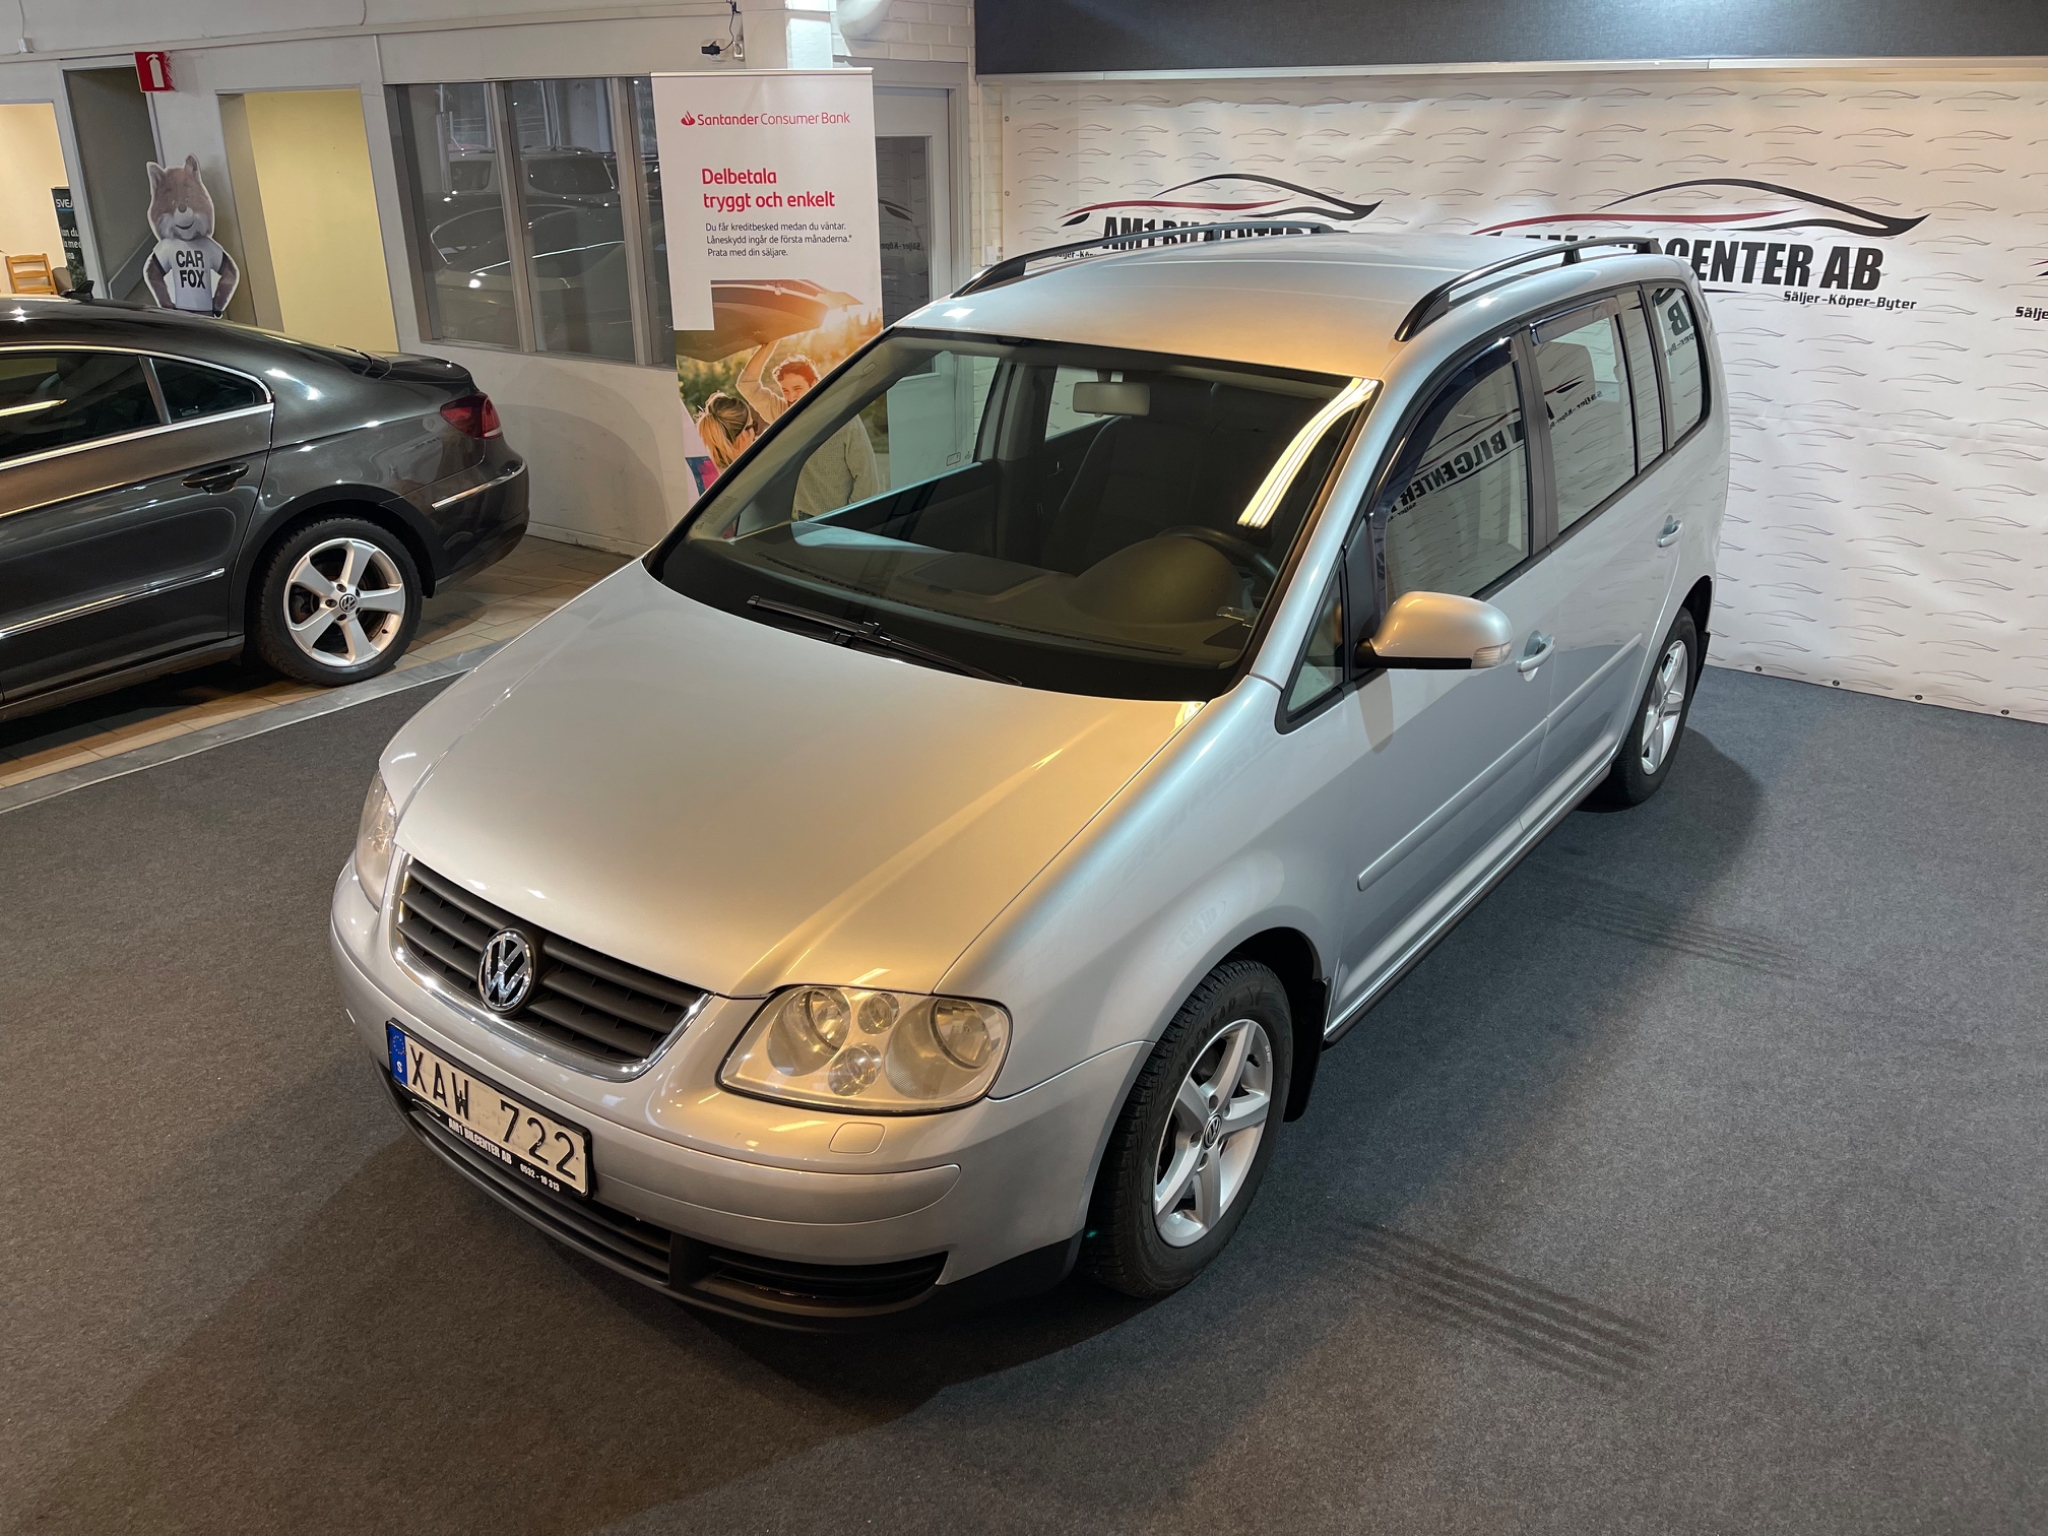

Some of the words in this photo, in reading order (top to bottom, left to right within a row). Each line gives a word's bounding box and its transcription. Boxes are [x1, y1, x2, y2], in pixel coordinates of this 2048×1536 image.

[697, 113, 759, 126] Santander
[760, 112, 819, 125] Consumer
[821, 111, 851, 124] Bank
[701, 167, 777, 185] Delbetala
[55, 198, 74, 208] SVE
[703, 192, 751, 213] tryggt
[755, 191, 783, 208] och
[787, 190, 836, 207] enkelt
[705, 222, 717, 232] Du
[718, 222, 729, 232] får
[730, 222, 779, 232] kreditbesked
[780, 222, 807, 231] medan
[808, 222, 819, 231] du
[820, 222, 847, 231] väntar.
[706, 234, 747, 246] Låneskydd
[748, 234, 768, 247] ingår
[769, 234, 779, 244] de
[780, 234, 803, 244] första
[175, 250, 205, 269] CAR
[707, 248, 728, 257] Prata
[729, 247, 747, 257] med
[748, 247, 760, 257] din
[761, 248, 789, 258] säljare.
[1818, 246, 1884, 291] AB
[179, 269, 206, 289] FOX
[396, 1060, 404, 1074] S
[409, 1044, 470, 1121] XAW
[500, 1098, 577, 1182] 722
